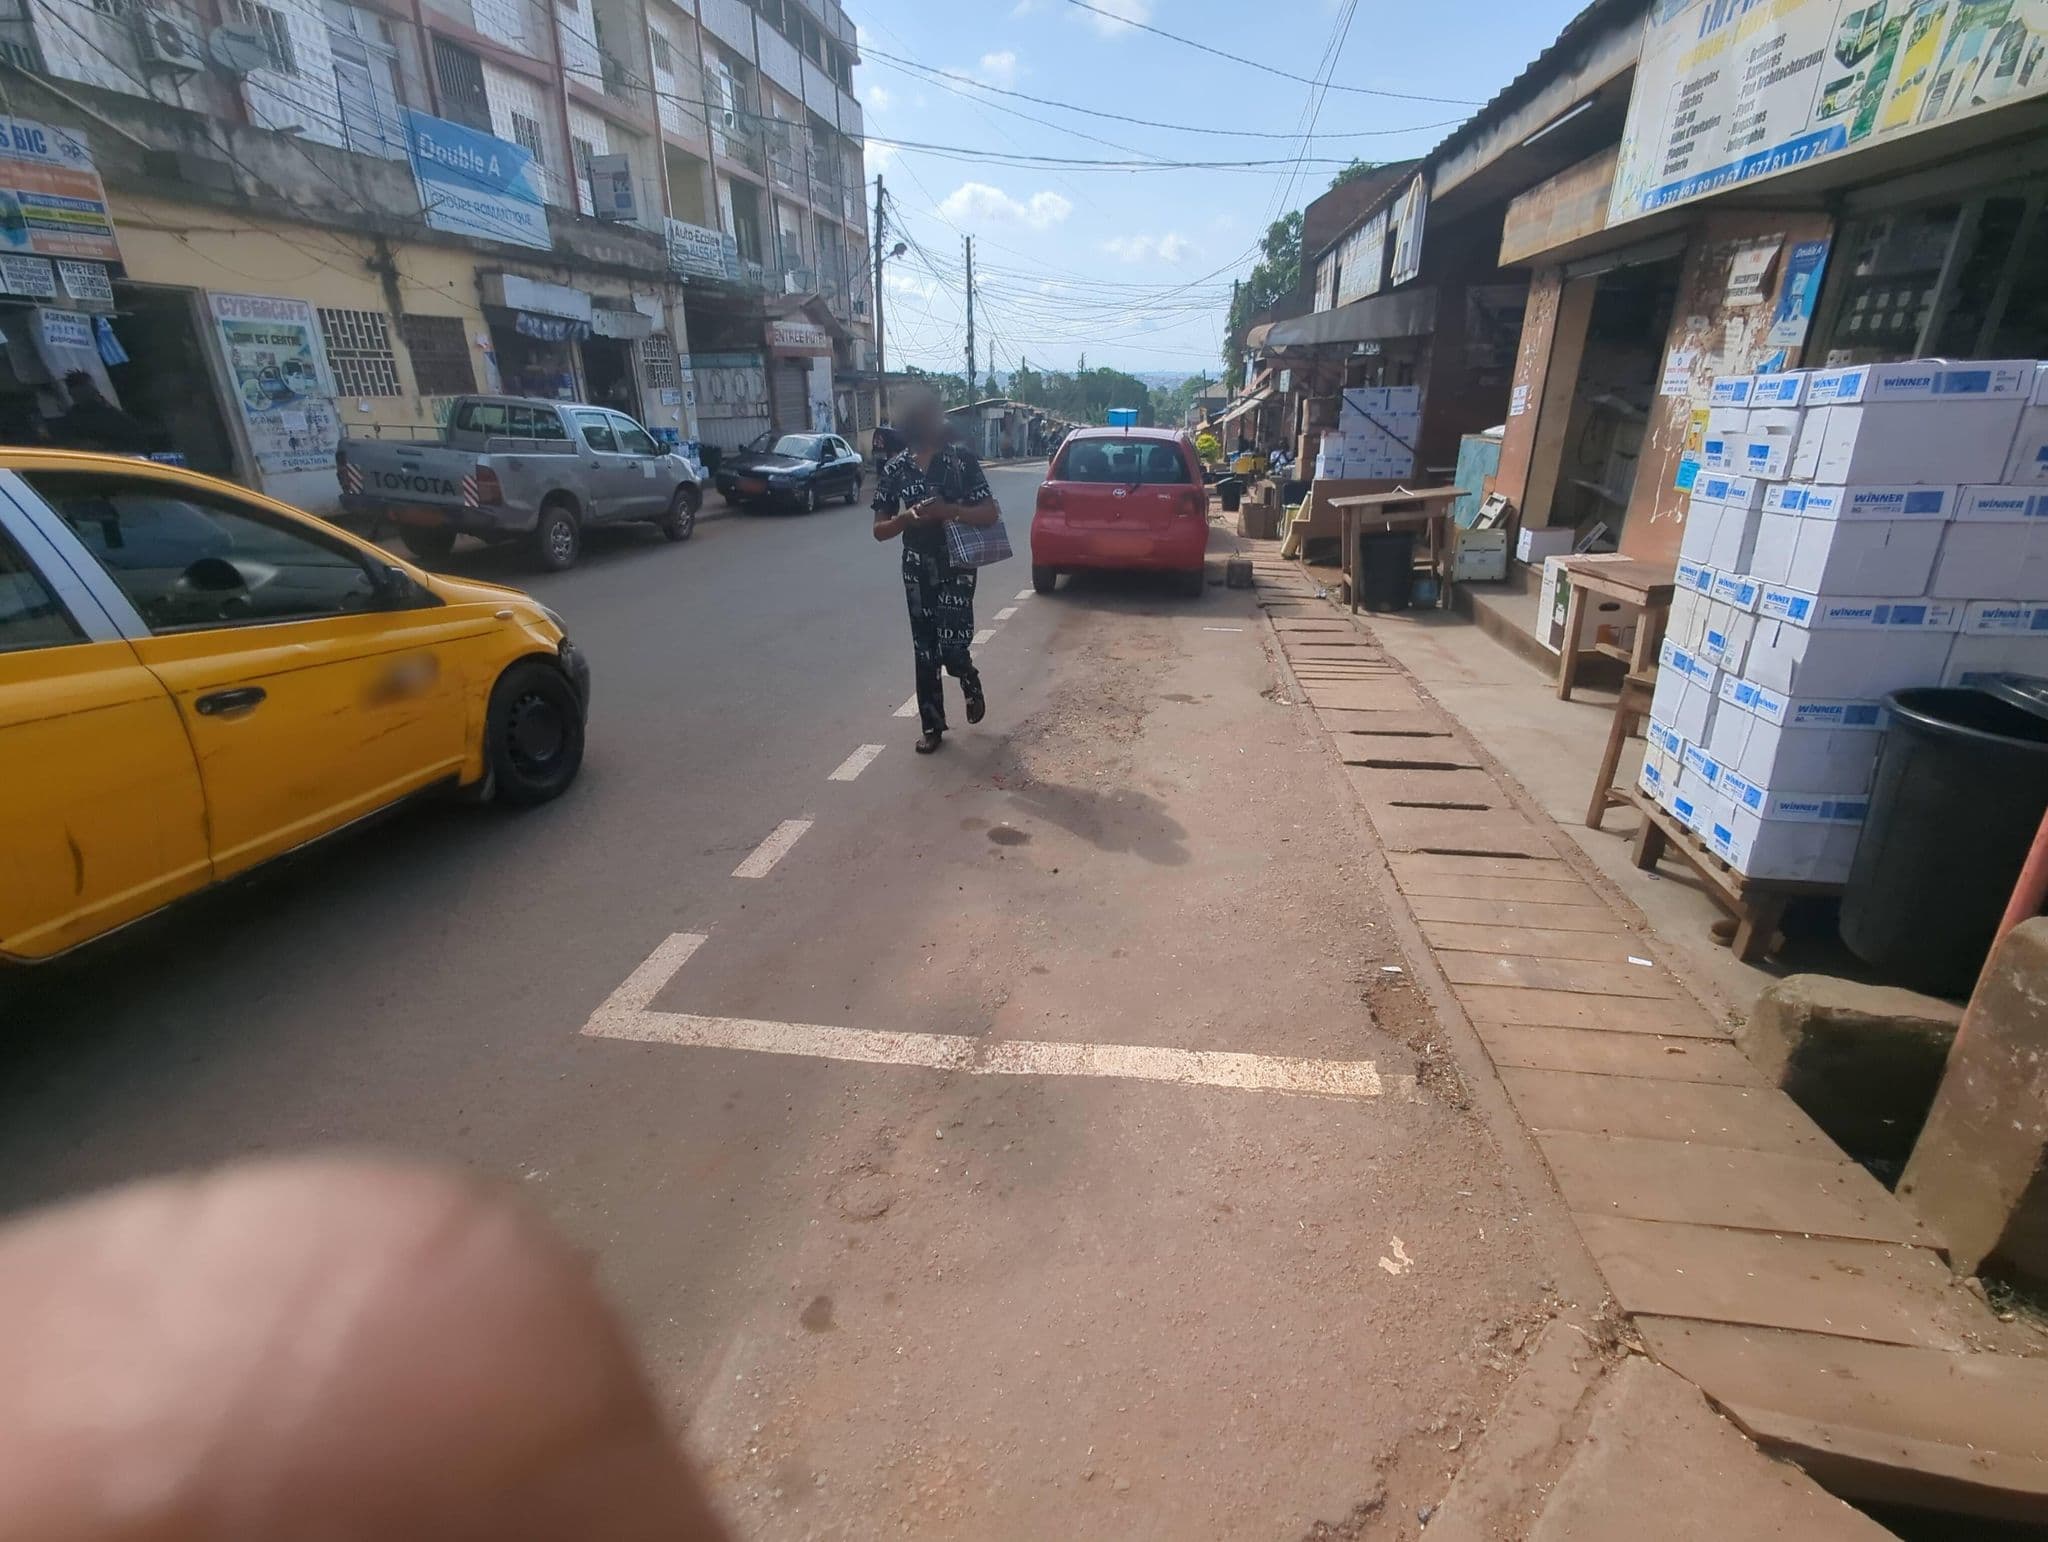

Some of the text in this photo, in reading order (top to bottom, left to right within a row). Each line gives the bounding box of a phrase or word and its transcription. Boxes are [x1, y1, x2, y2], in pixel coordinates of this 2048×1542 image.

[11, 125, 48, 154] BIC
[419, 132, 501, 177] Double A
[1773, 151, 1787, 169] 81
[1791, 145, 1806, 163] 17
[61, 261, 107, 276] PAPETERIE
[45, 312, 76, 323] AGENDA
[370, 471, 456, 496] TOYOTA
